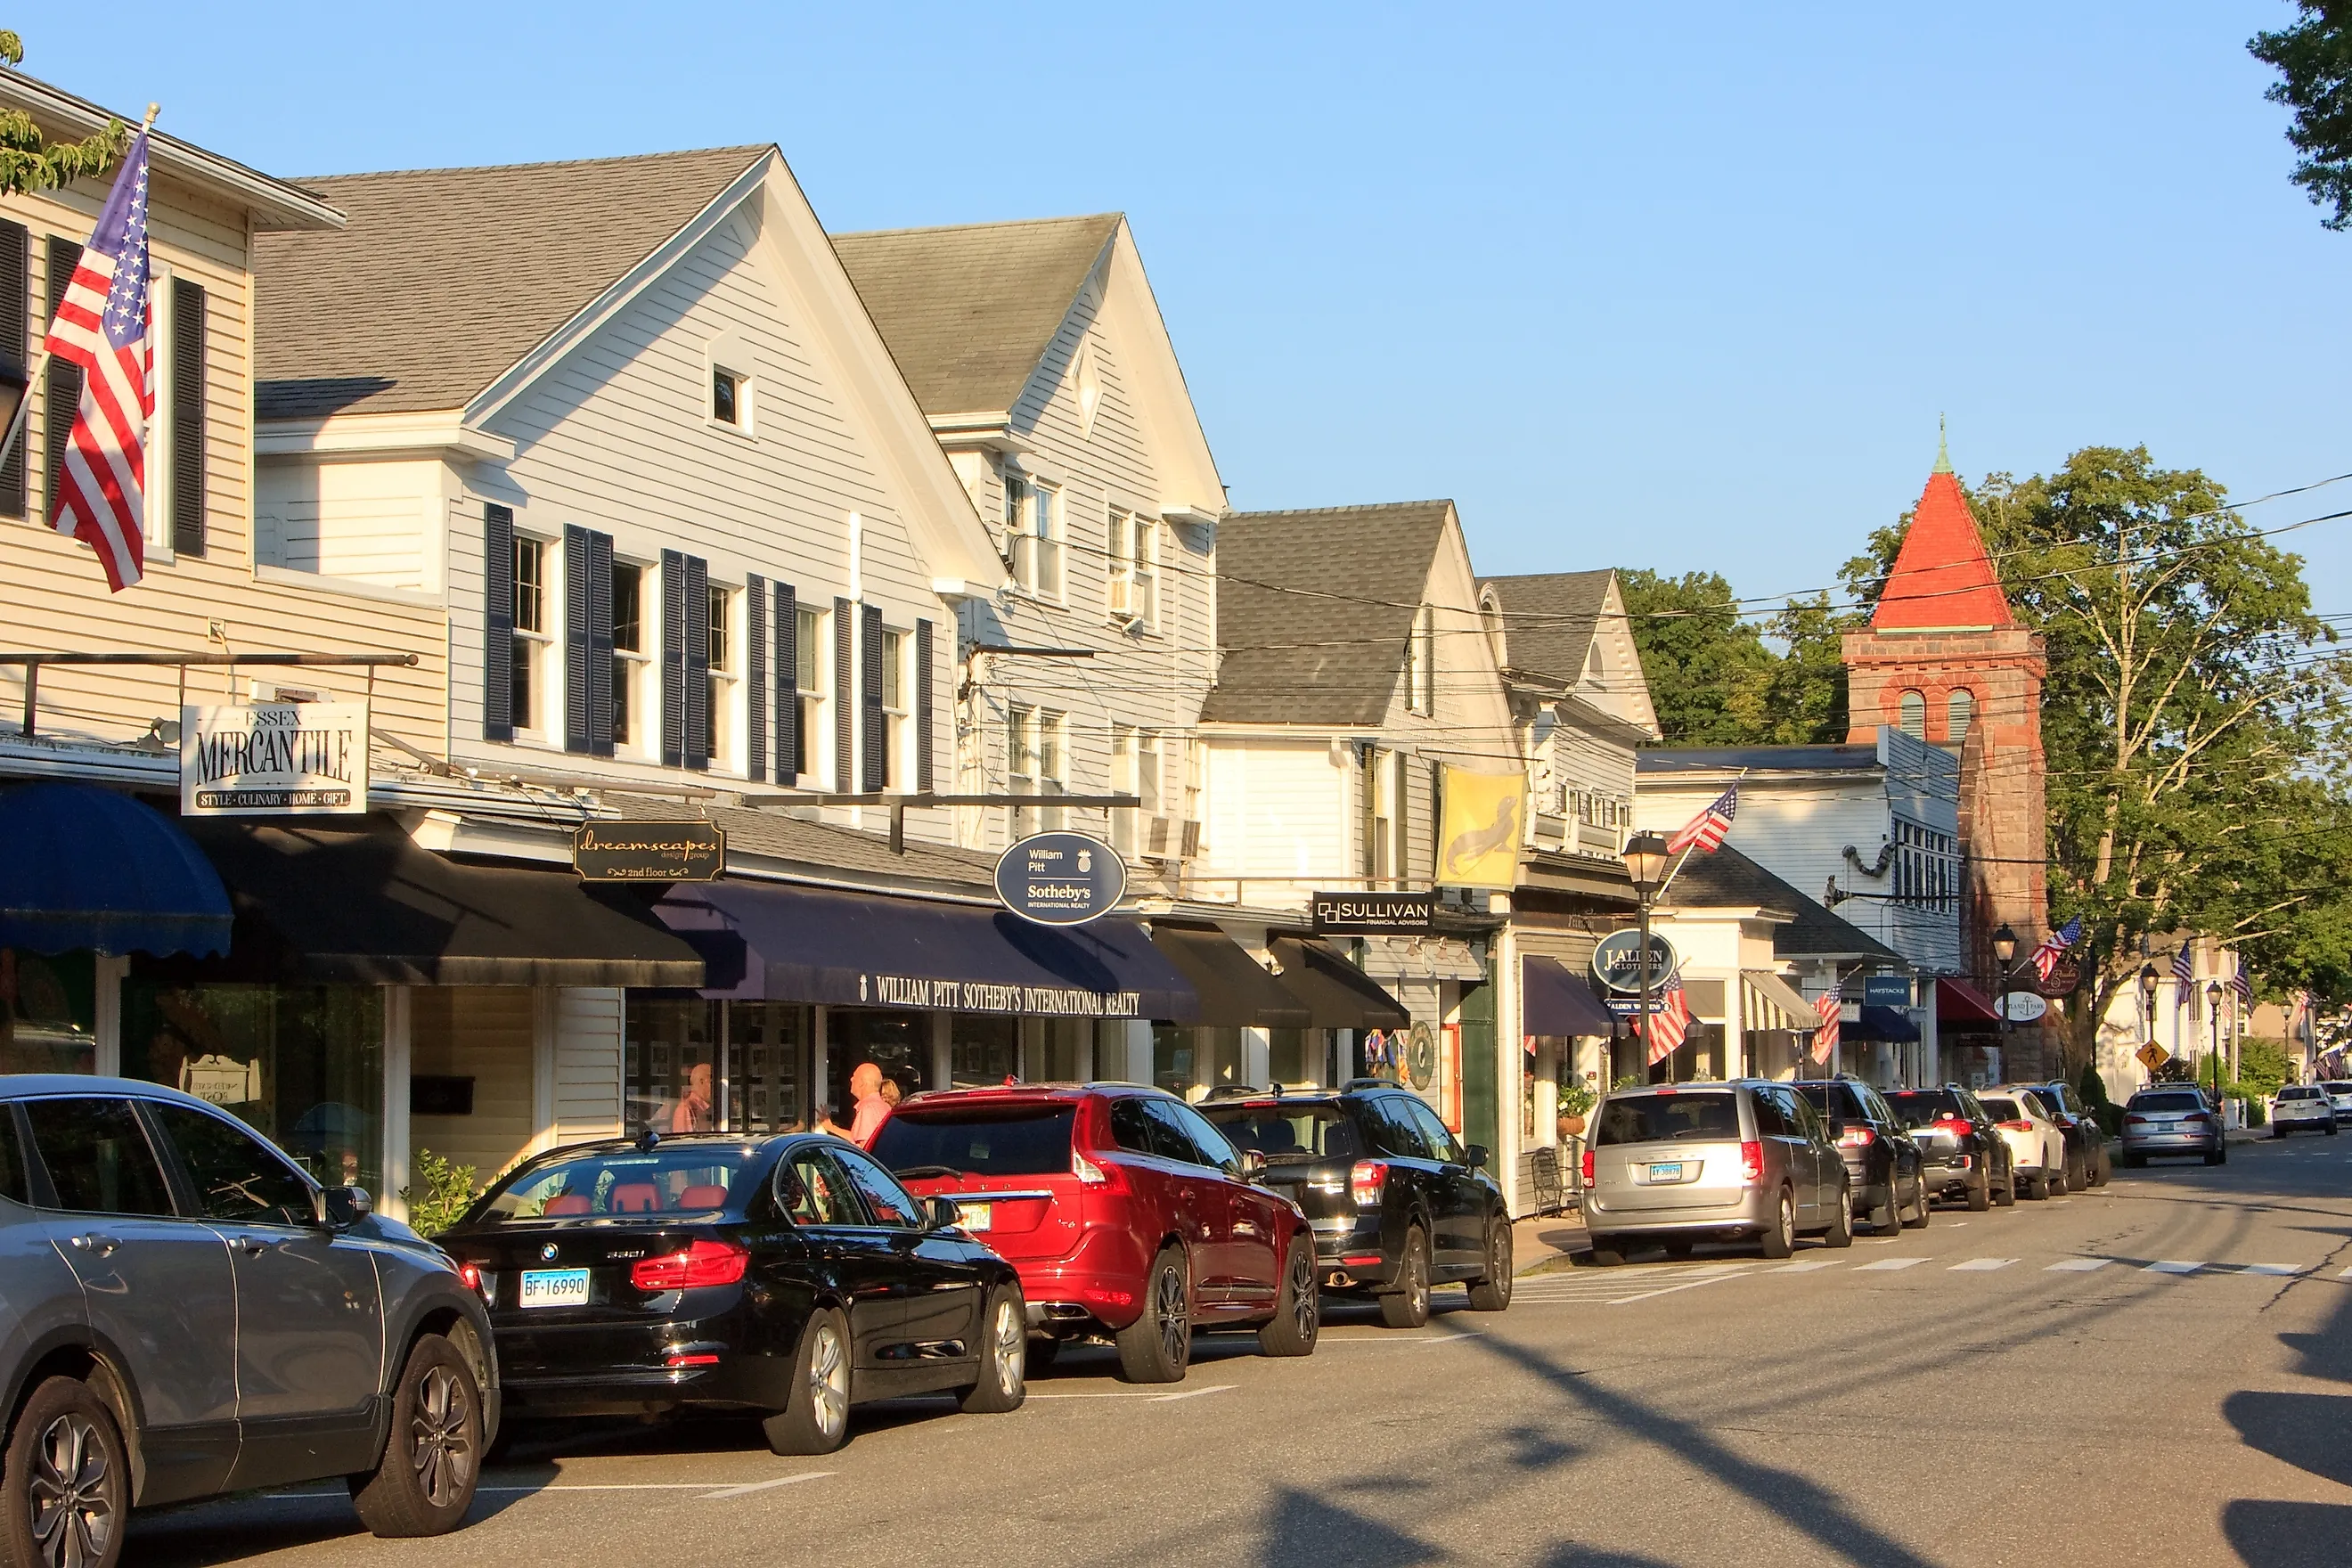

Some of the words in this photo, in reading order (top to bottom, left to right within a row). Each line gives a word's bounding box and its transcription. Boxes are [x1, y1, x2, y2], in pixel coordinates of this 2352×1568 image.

[245, 711, 302, 727] ESSEX
[195, 730, 353, 787] MERCANTILE
[200, 793, 232, 805] STYLE
[238, 793, 282, 805] CULINARY
[289, 792, 317, 804] HOME
[323, 792, 347, 804] GIFT
[580, 829, 717, 862] dreamscapes
[689, 852, 710, 861] group
[1028, 849, 1063, 860] William
[627, 868, 644, 878] 2nd
[645, 867, 667, 878] floor
[1028, 862, 1046, 872] Pitt
[1027, 884, 1091, 901] Sotheby's
[1341, 902, 1429, 918] SULLIVAN
[876, 976, 930, 1006] WILLIAM
[933, 980, 960, 1008] PITT
[963, 982, 1021, 1012] SOTHEBY'S
[1024, 987, 1104, 1016] INTERNATIONAL
[1105, 992, 1140, 1016] REALTY
